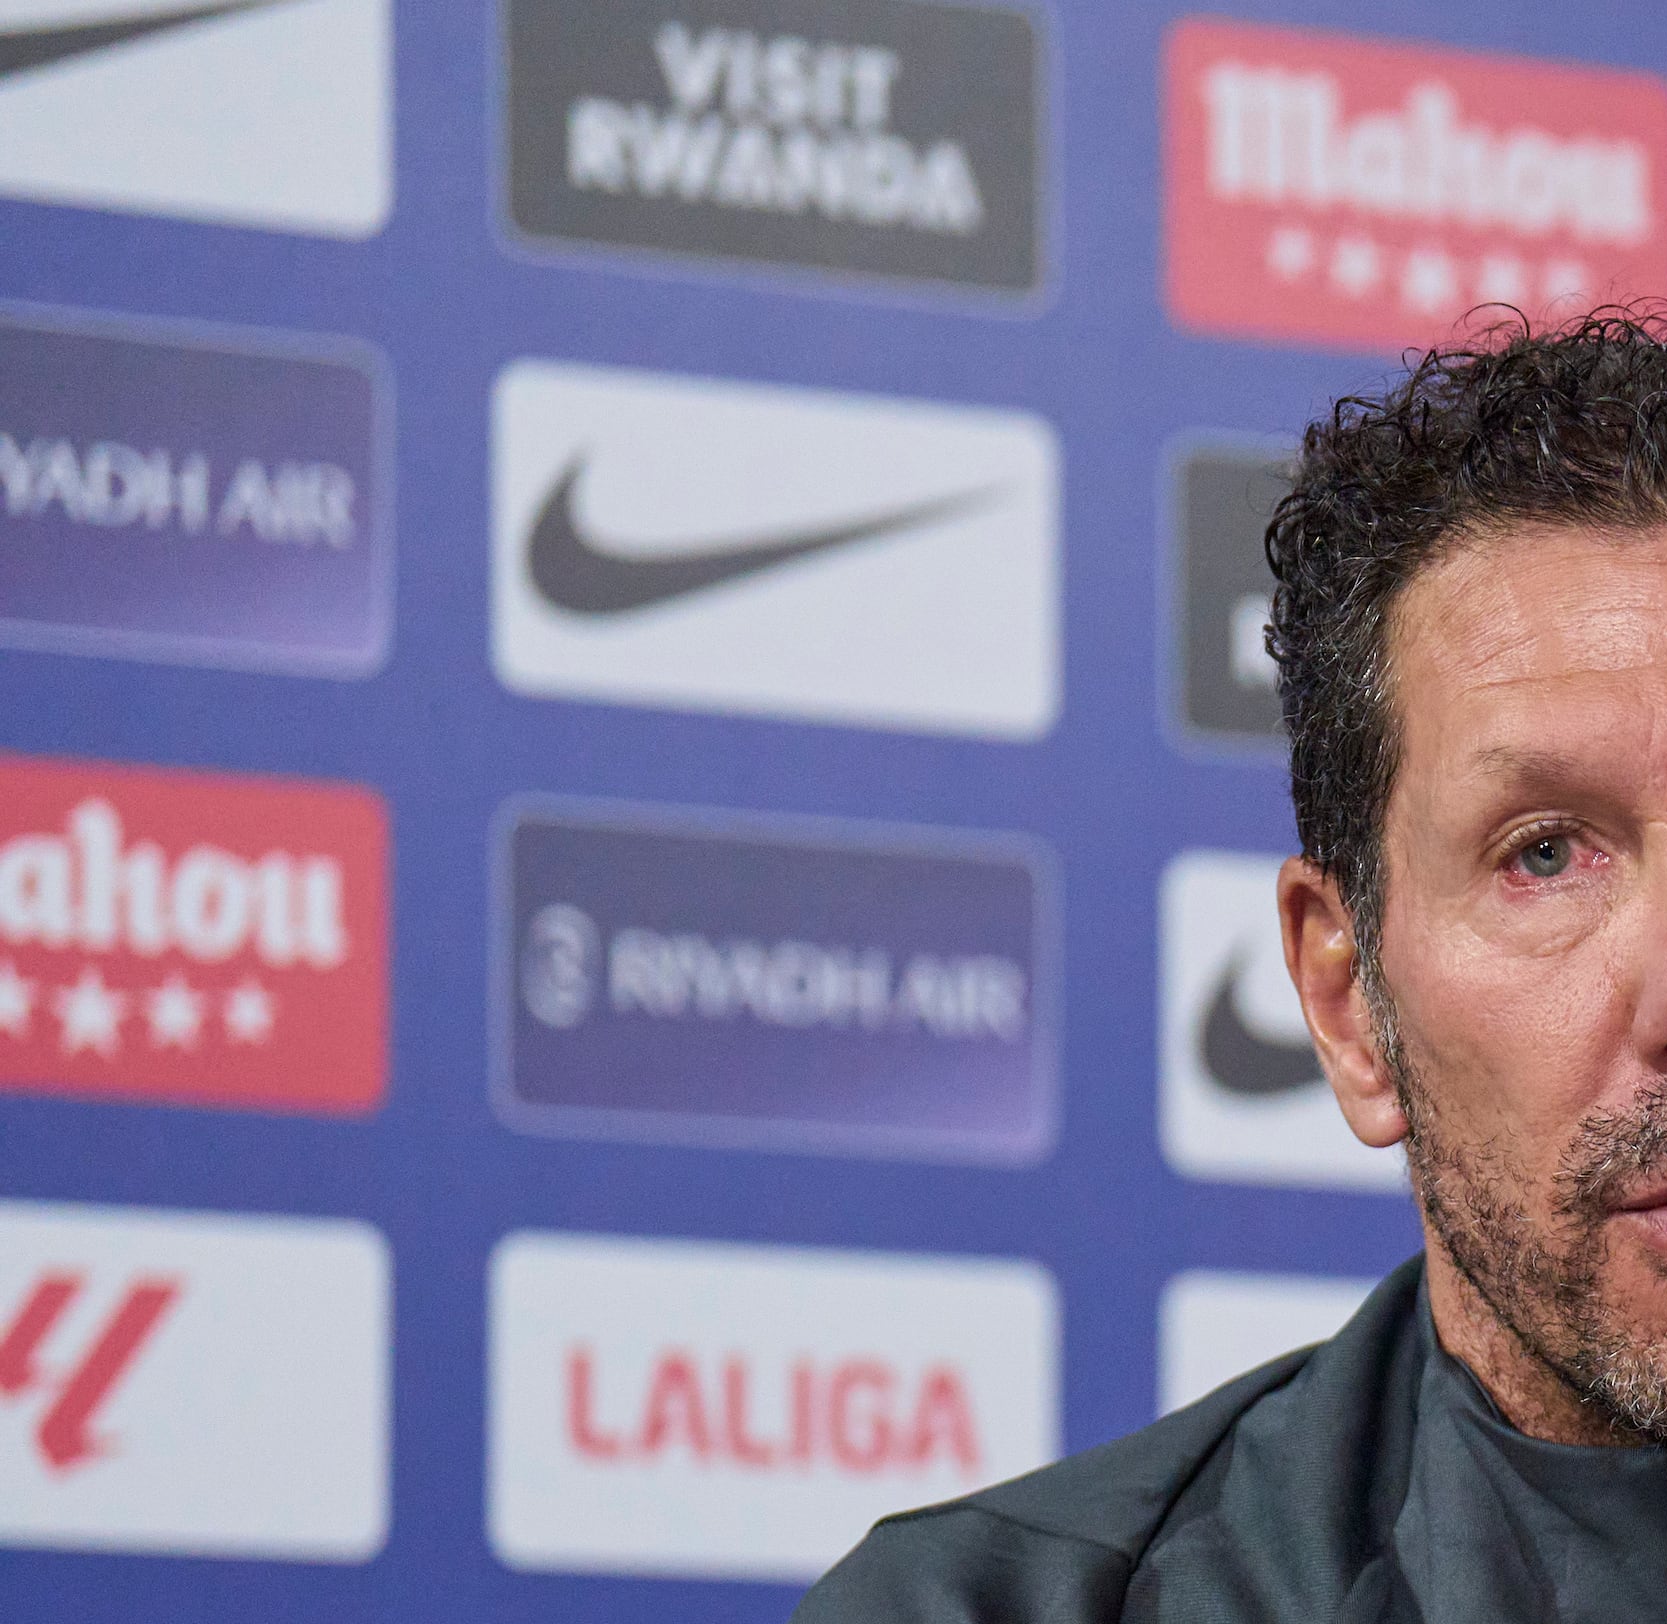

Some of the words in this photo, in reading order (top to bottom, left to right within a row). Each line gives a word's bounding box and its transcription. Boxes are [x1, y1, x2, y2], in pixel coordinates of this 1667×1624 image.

[652, 20, 900, 122] VISIT
[566, 98, 982, 234] RWANDA
[1206, 60, 1652, 242] Mahou
[214, 456, 356, 550] AIR
[0, 798, 348, 968] ahou
[566, 1342, 980, 1474] LALIGA
